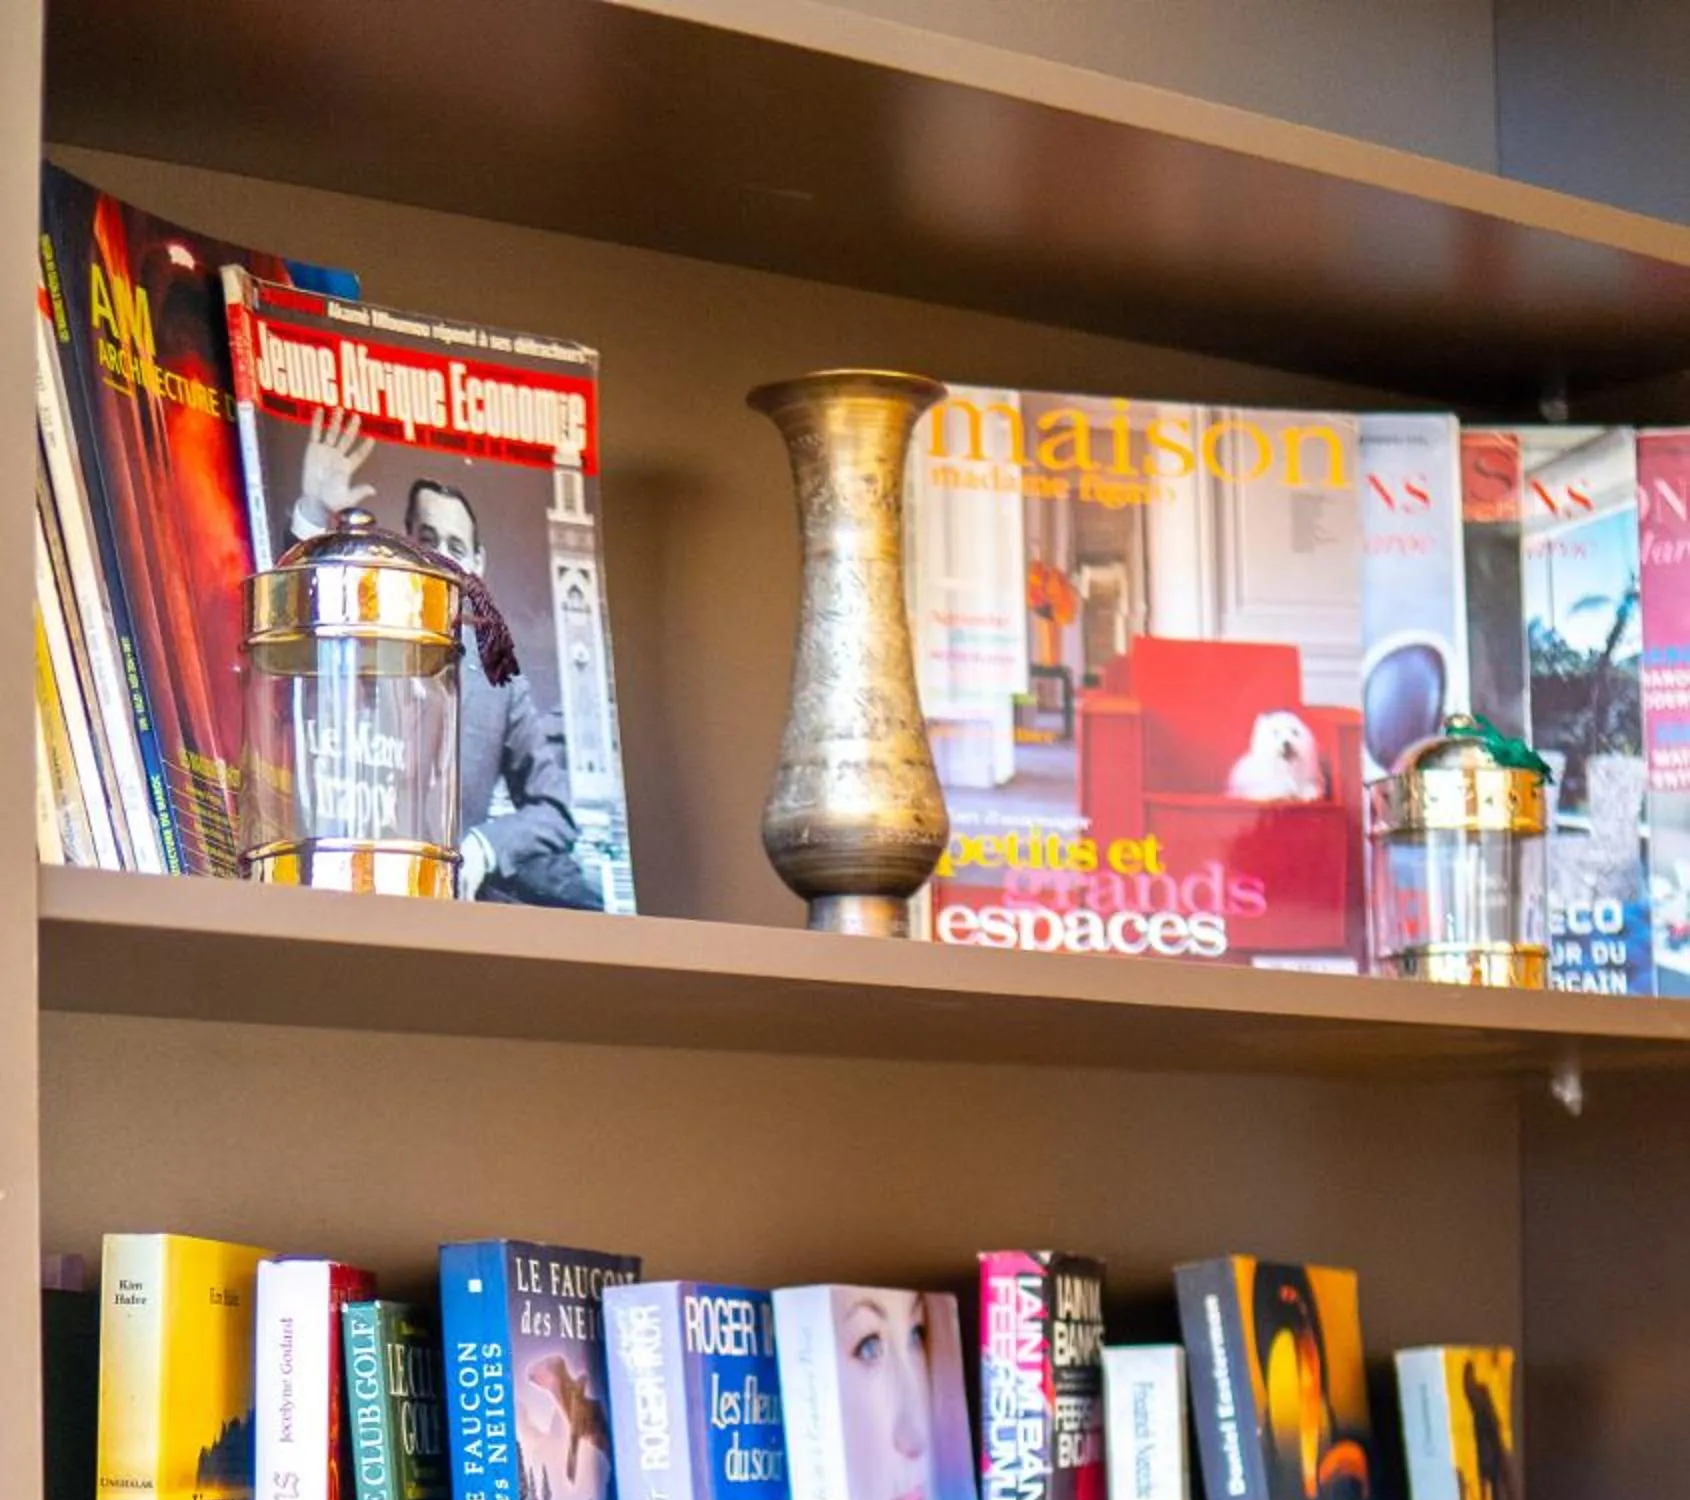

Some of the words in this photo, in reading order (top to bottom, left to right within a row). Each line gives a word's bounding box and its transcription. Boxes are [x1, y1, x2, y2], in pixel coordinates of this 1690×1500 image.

[257, 320, 340, 407] Jeune
[340, 340, 447, 441] Afrique
[449, 362, 587, 450] Economie
[928, 397, 1353, 489] maison
[930, 464, 1072, 499] madame
[935, 824, 1098, 877] petits
[1106, 833, 1166, 875] et
[1001, 861, 1268, 918] grands
[937, 904, 1228, 958] espaces
[514, 1257, 542, 1294] LE
[351, 1317, 380, 1400] GOLF
[521, 1300, 553, 1338] des
[684, 1295, 758, 1357] ROGER
[1016, 1277, 1046, 1363] IAIN
[456, 1341, 486, 1477] FAUCON
[482, 1342, 512, 1465] NEIGES
[711, 1373, 742, 1430] Les
[743, 1373, 780, 1426] fleu
[988, 1276, 1018, 1484] FEERSUM
[357, 1404, 386, 1486] CLUB
[634, 1375, 672, 1471] ROGER
